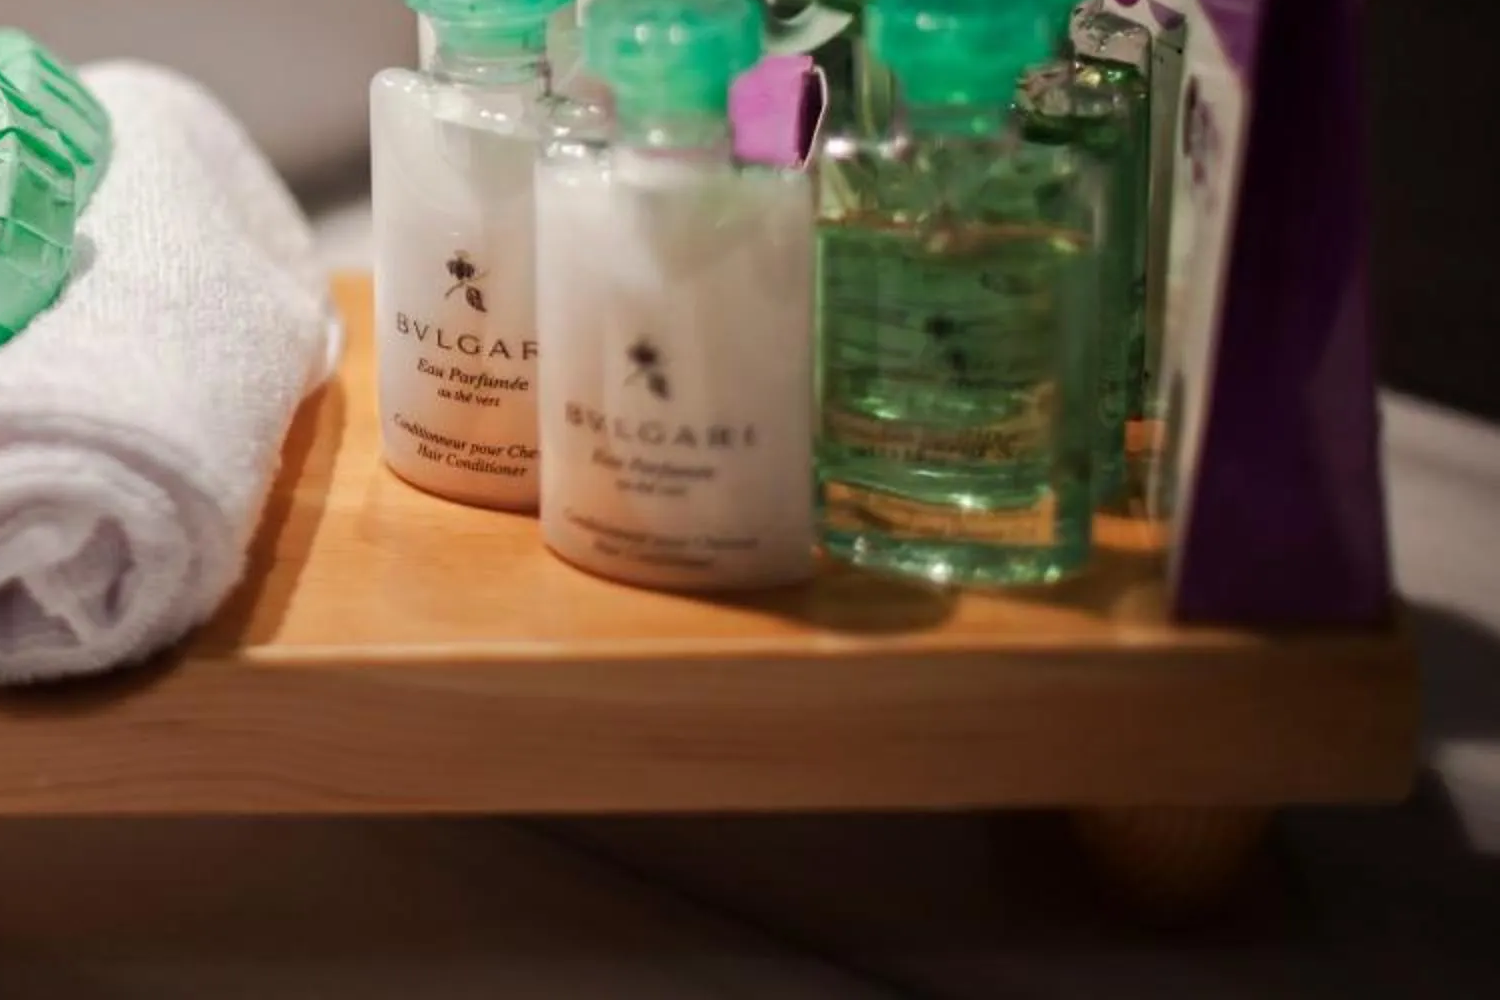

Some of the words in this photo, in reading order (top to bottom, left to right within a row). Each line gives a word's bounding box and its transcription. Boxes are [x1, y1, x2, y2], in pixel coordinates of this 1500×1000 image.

[417, 357, 444, 379] Eau
[449, 366, 530, 392] Parfumée
[417, 443, 444, 463] Hair
[445, 452, 529, 478] Conditioner
